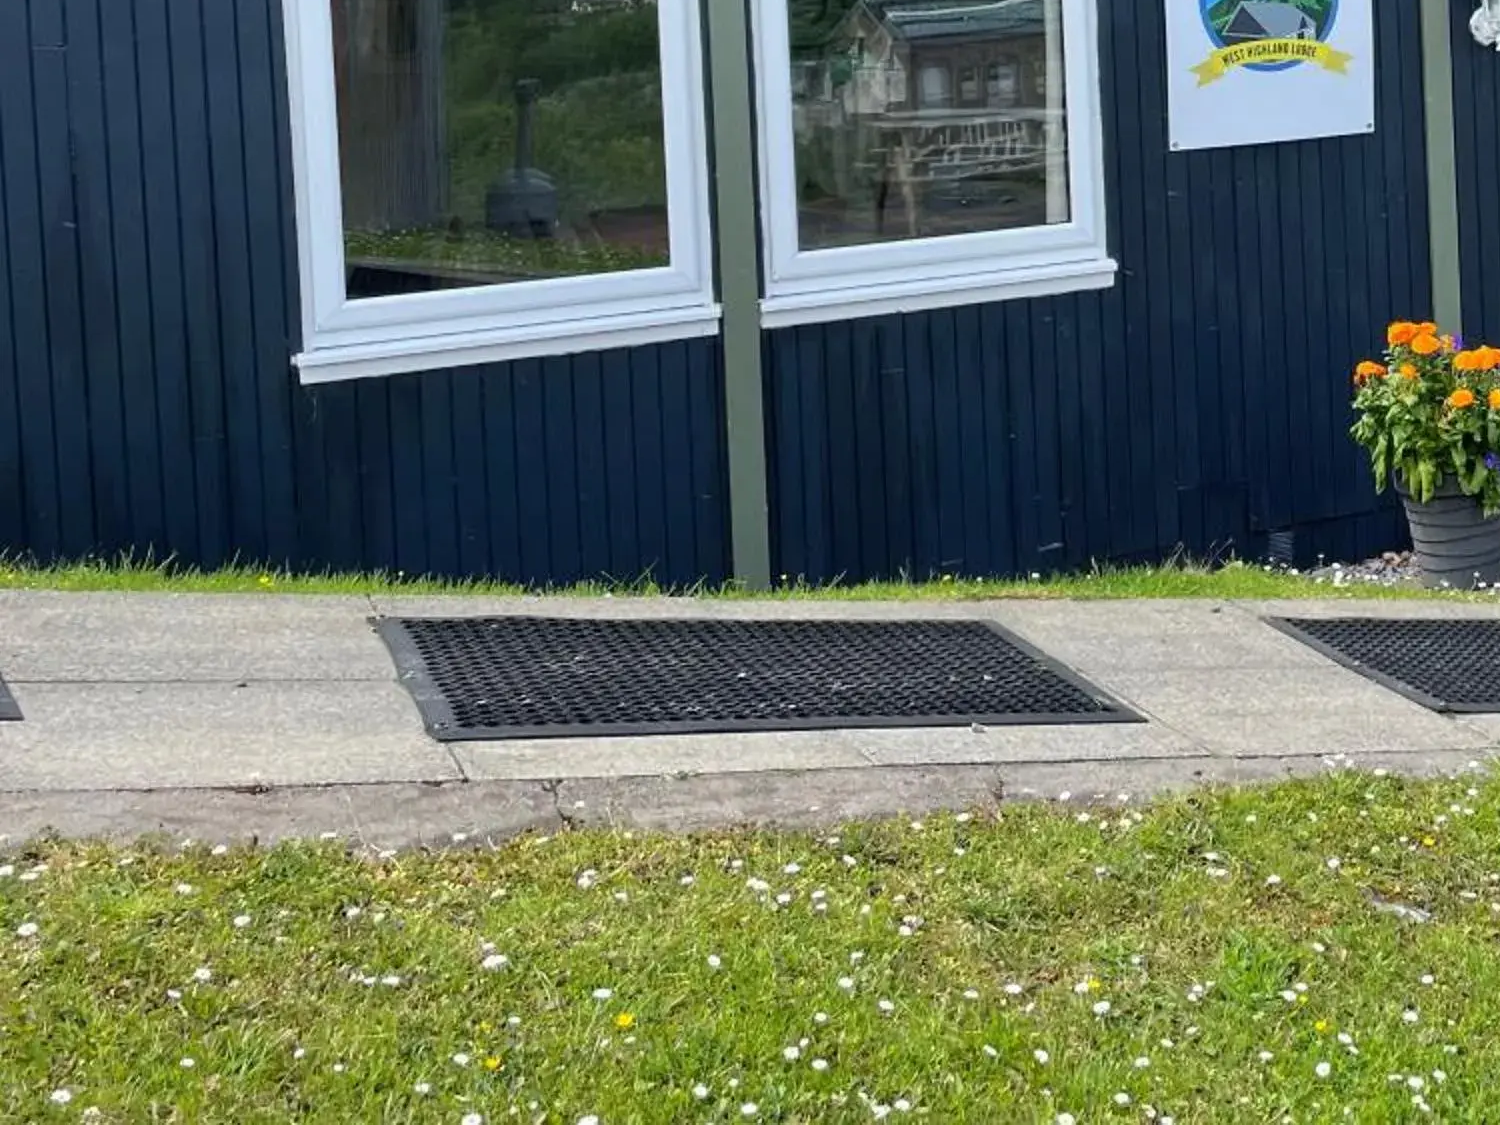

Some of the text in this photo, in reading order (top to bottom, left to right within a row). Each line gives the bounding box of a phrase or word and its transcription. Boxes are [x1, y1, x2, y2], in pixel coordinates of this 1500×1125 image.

[1221, 42, 1317, 65] WEST HIGHLAND LODGE
